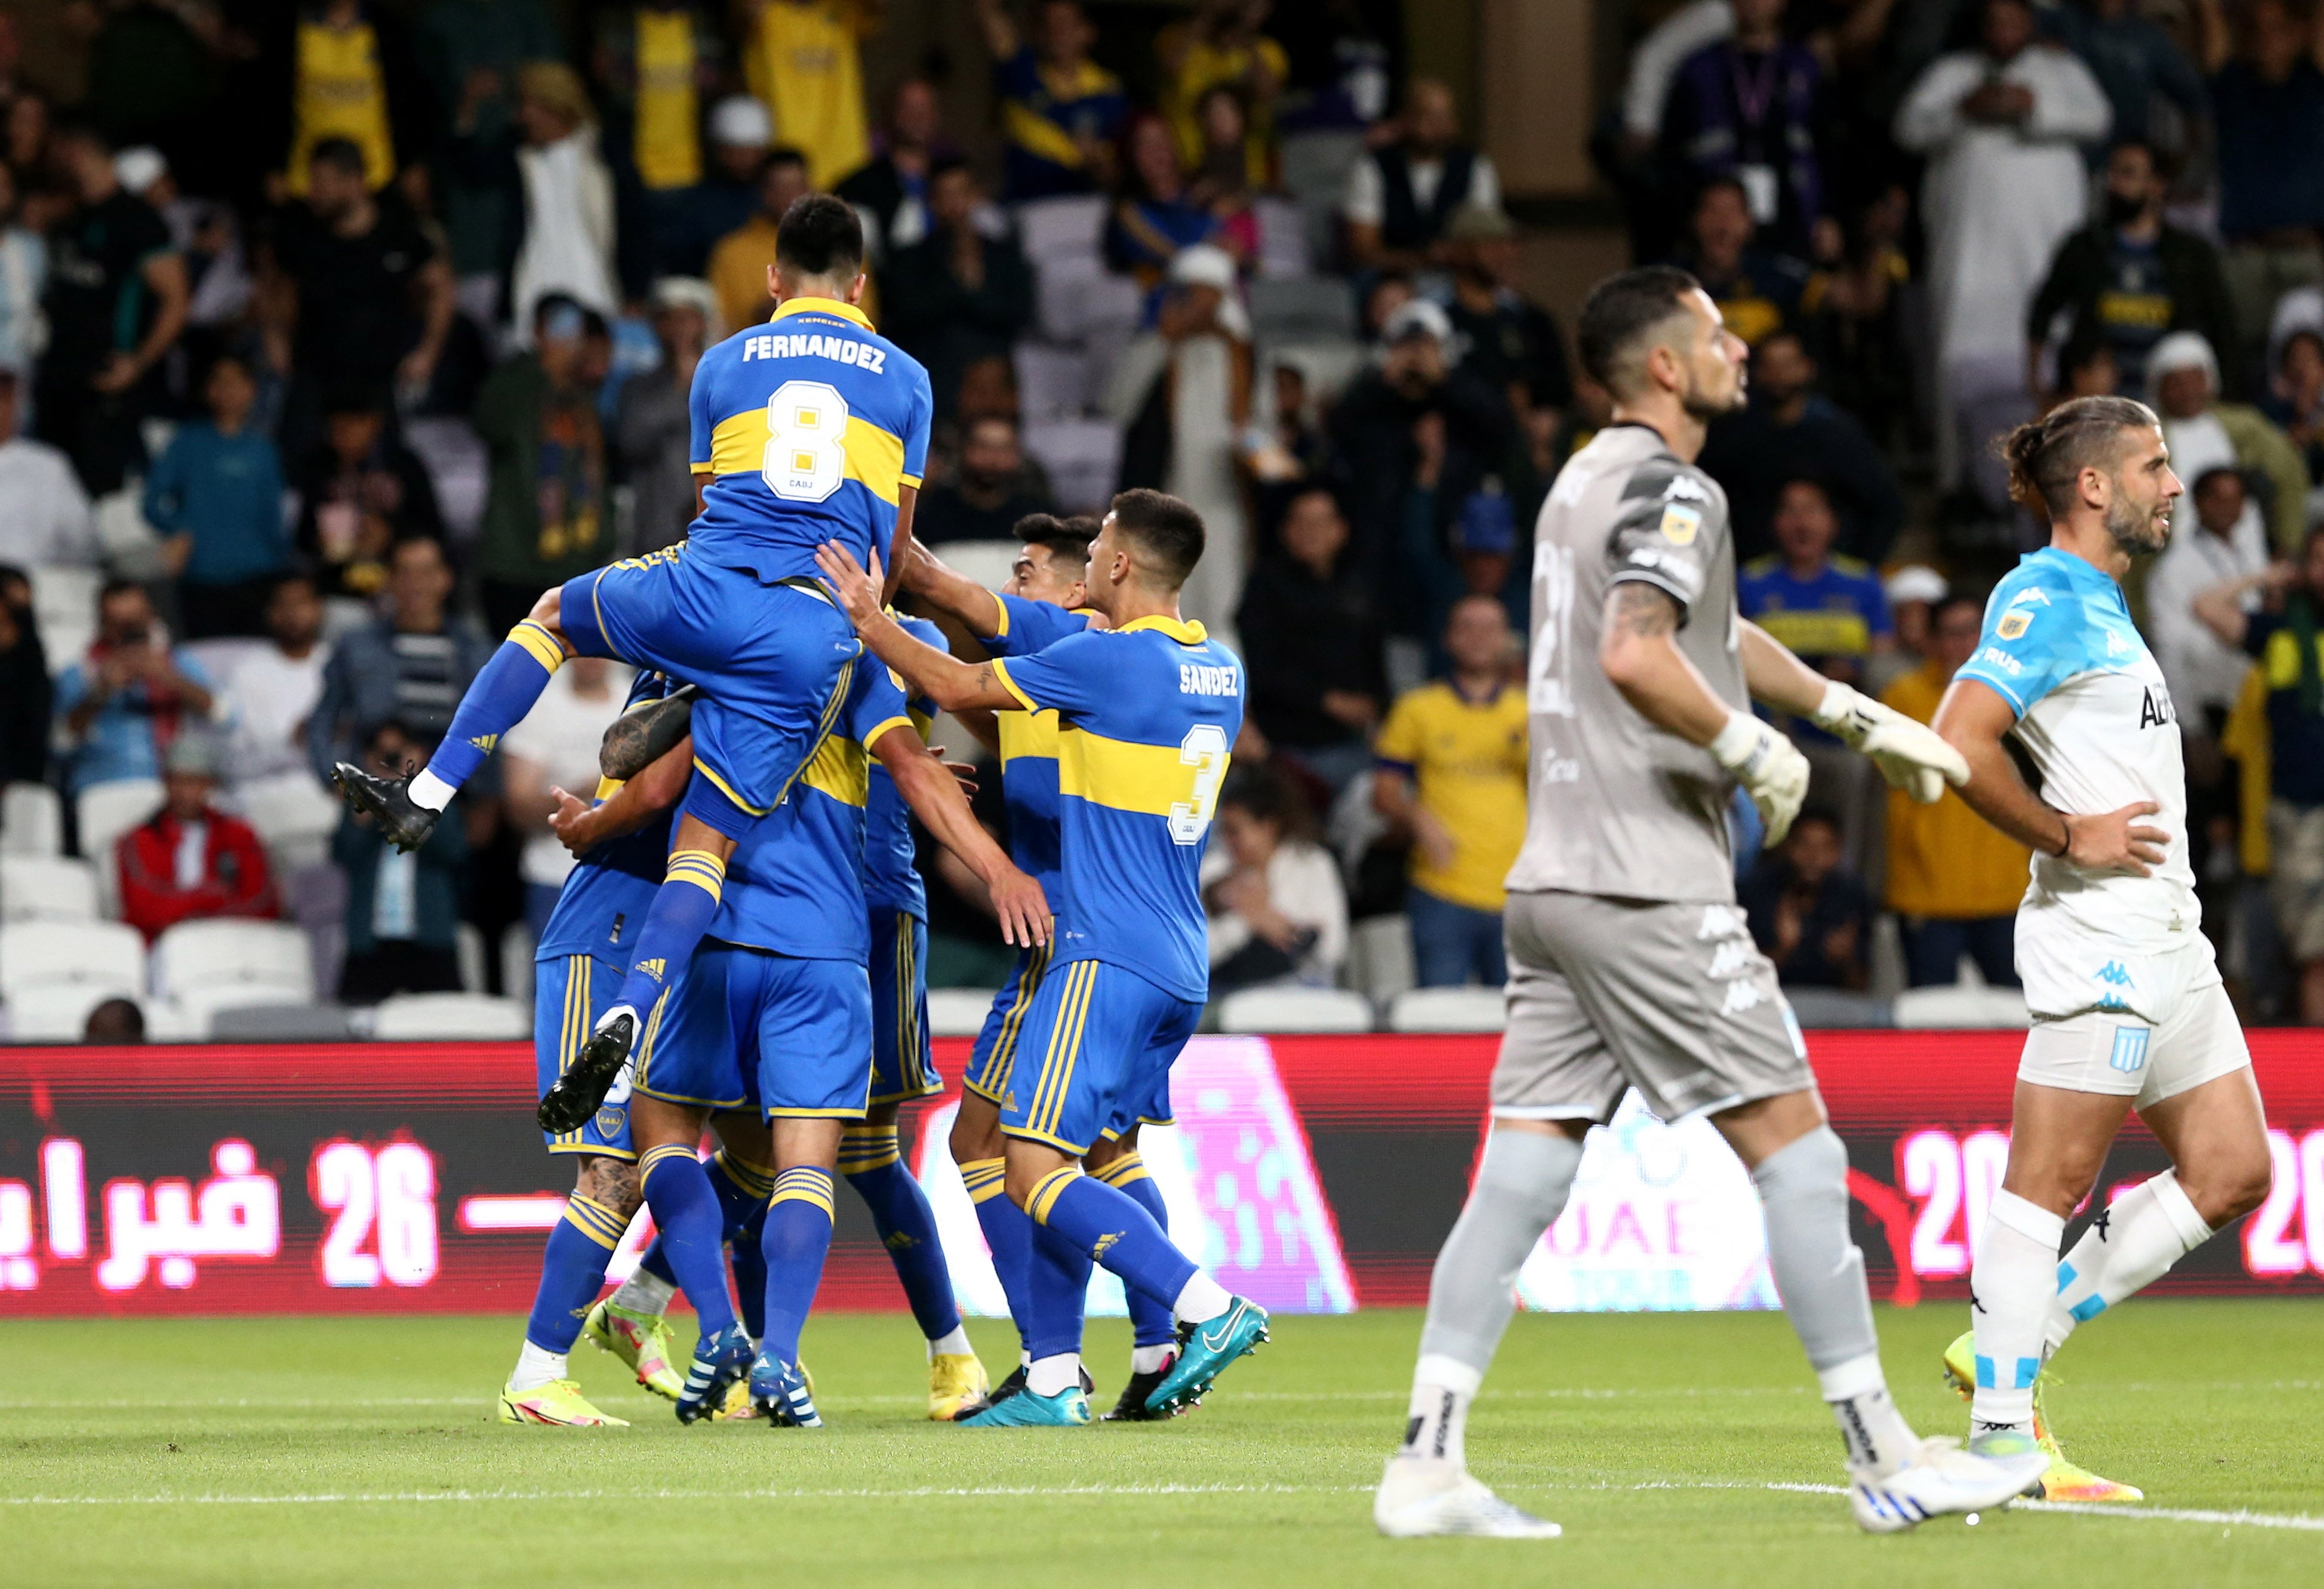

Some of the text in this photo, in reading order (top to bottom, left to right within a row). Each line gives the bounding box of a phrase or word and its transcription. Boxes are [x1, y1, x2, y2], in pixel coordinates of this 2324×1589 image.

[742, 334, 886, 375] FERNANDEZ
[762, 380, 849, 503] 8
[789, 479, 813, 489] CABJ
[1178, 664, 1238, 697] SANDEZ
[1984, 646, 2023, 676] RUS
[1166, 723, 1227, 846] 3
[635, 964, 663, 984] adidas
[0, 1138, 281, 1291] فبراي
[313, 1141, 441, 1288] 26
[1544, 1200, 1698, 1257] UAE
